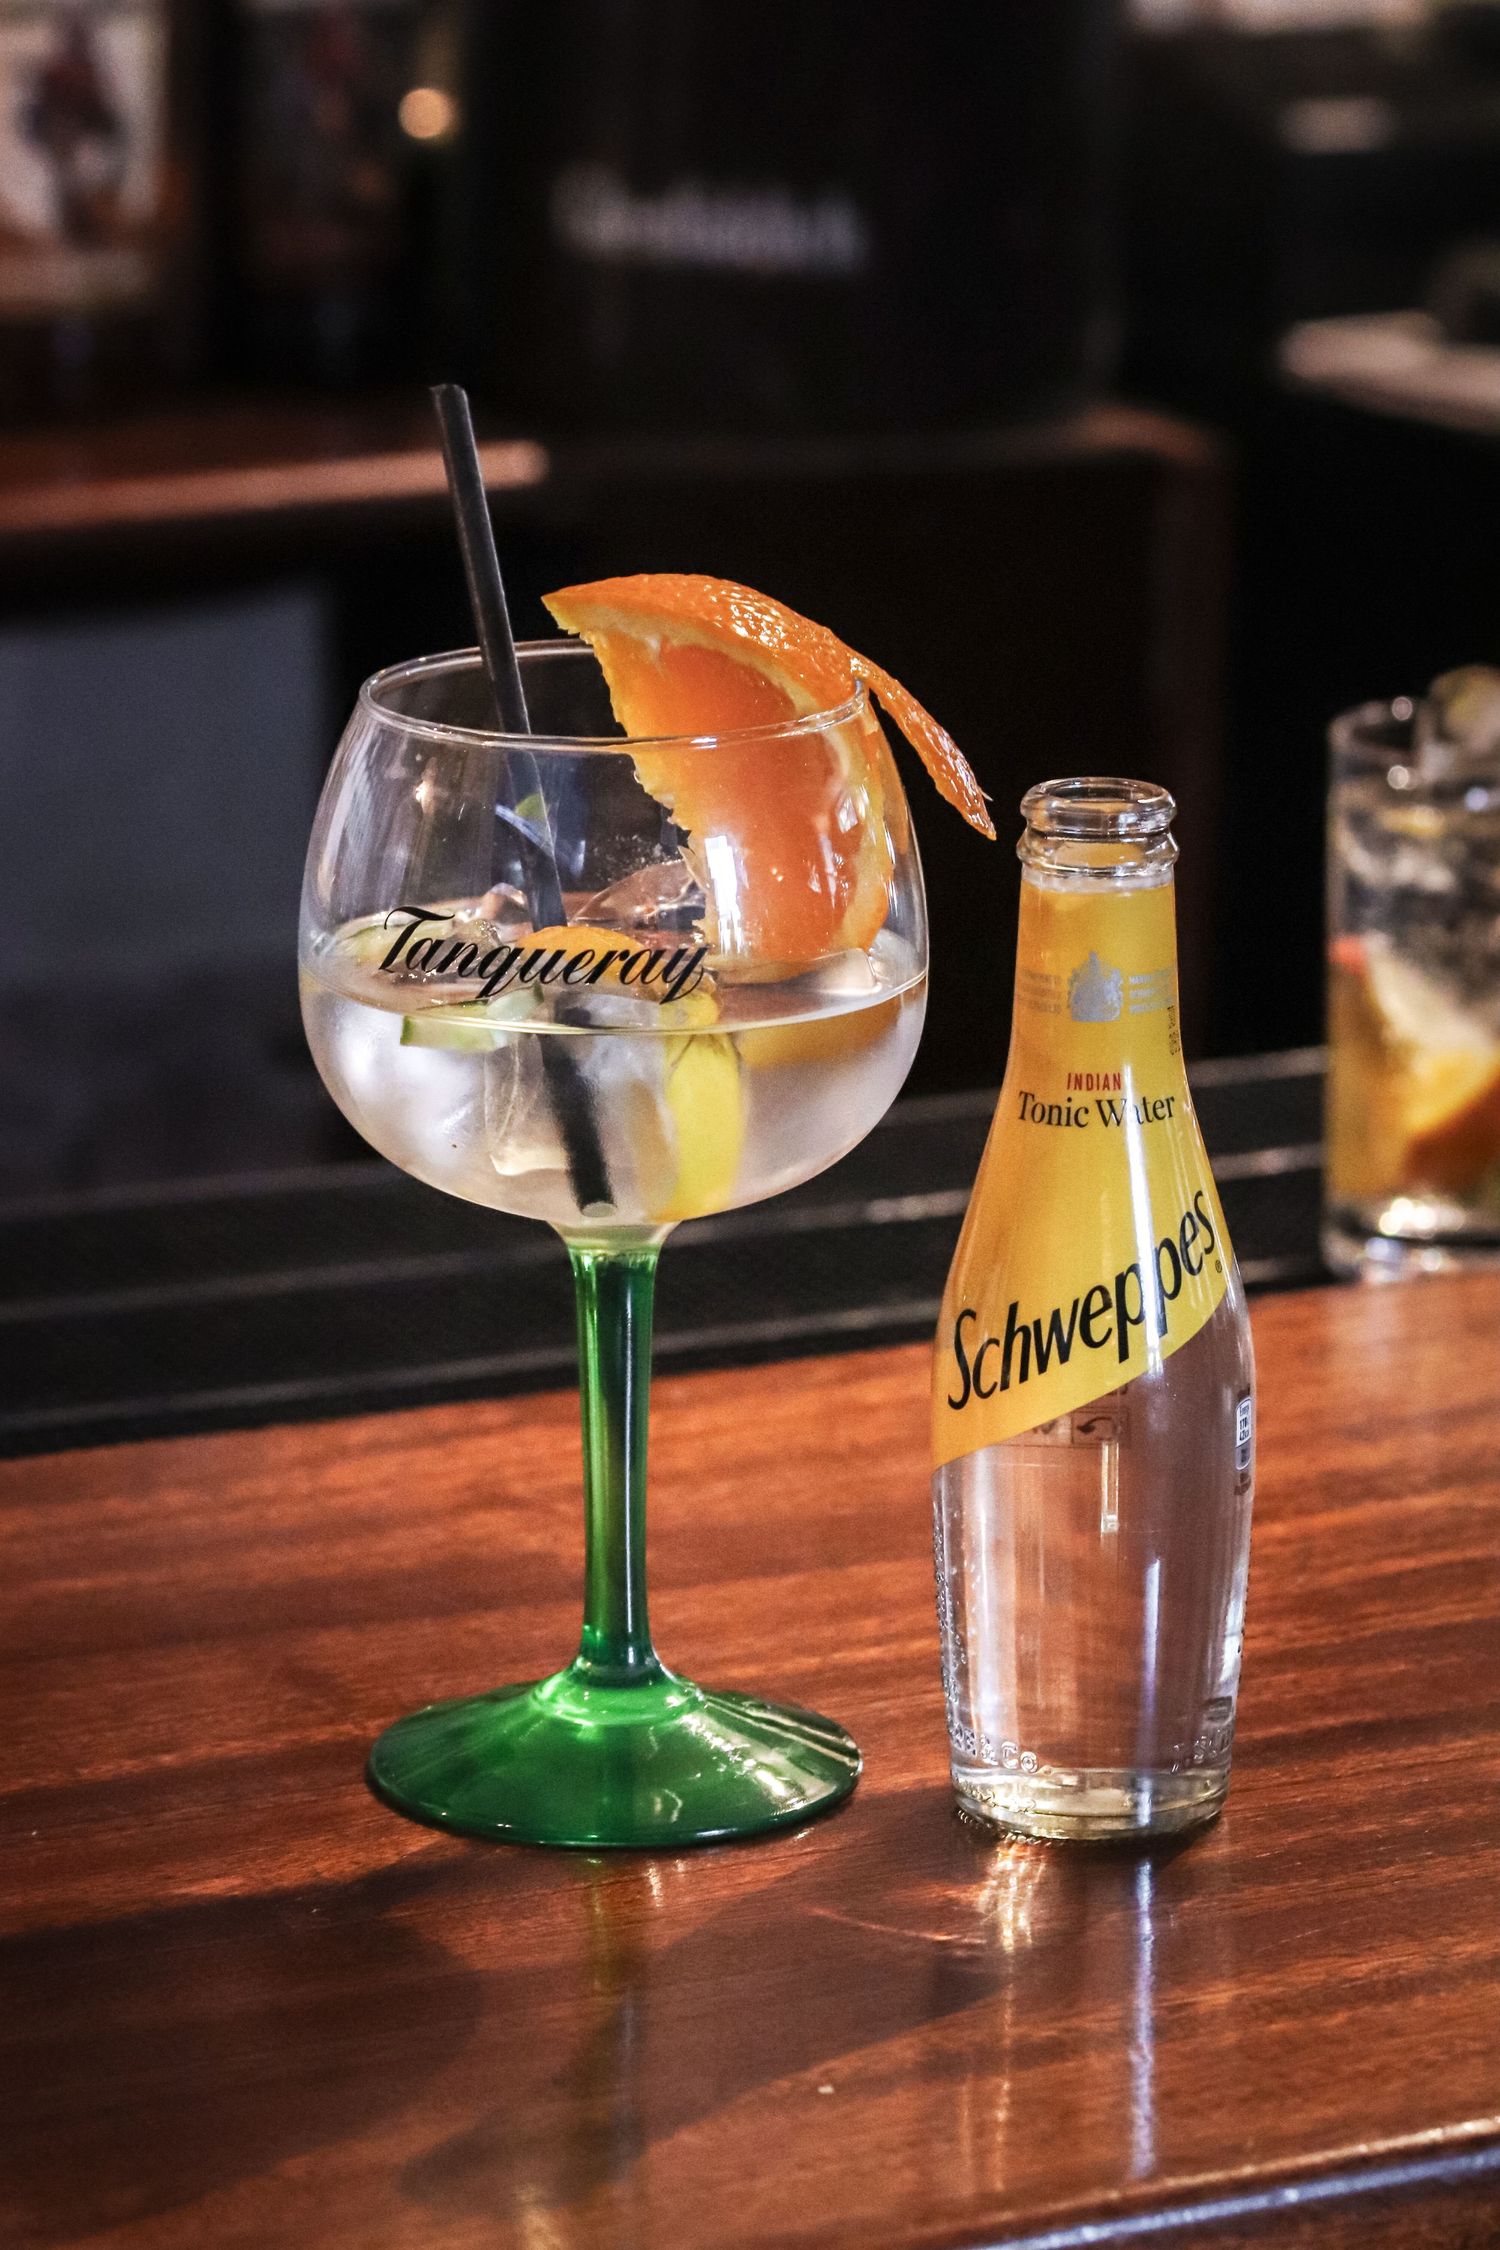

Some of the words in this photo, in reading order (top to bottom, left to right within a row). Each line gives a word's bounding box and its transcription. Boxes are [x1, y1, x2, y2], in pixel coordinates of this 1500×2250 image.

[379, 906, 711, 1004] Tanqueray
[1018, 1091, 1089, 1128] Tonic
[1066, 1073, 1121, 1091] INDIAN
[948, 1190, 1215, 1411] Schweppes
